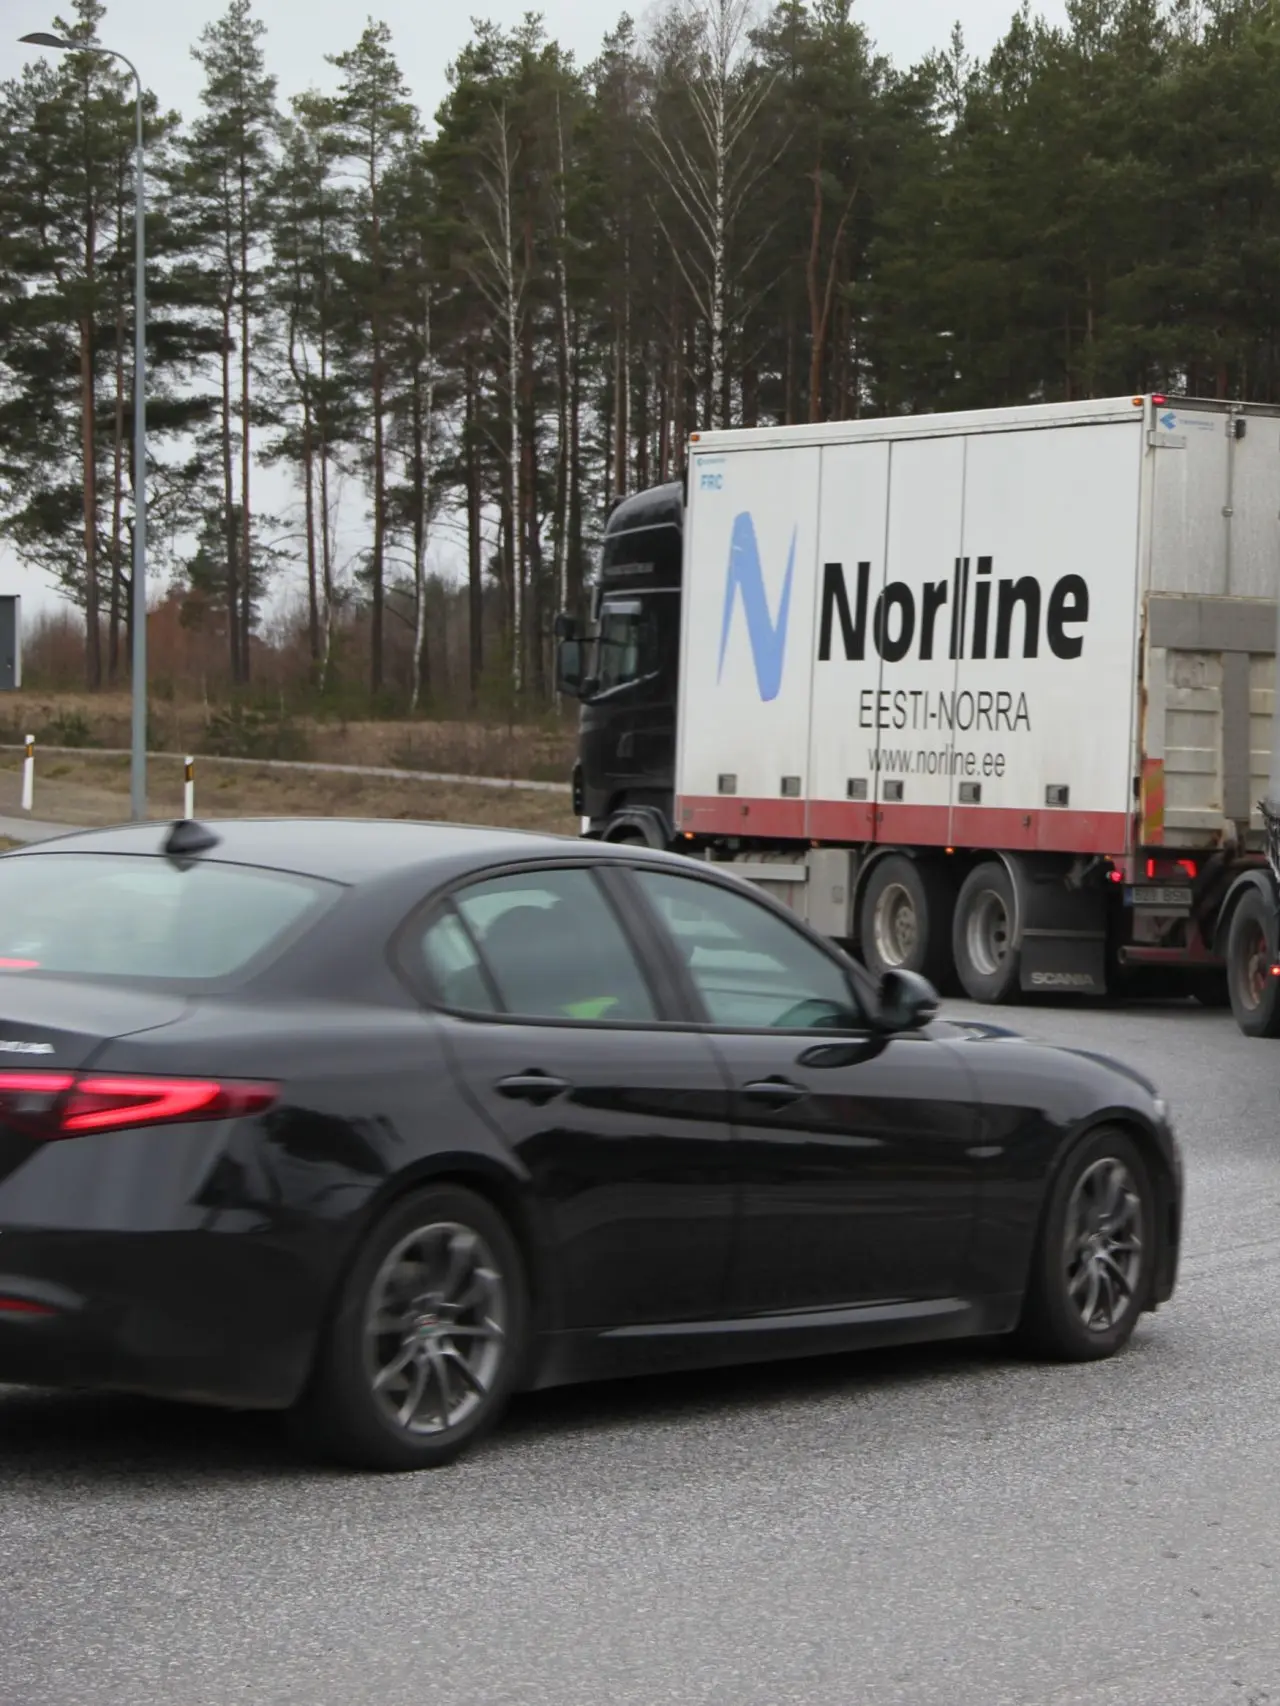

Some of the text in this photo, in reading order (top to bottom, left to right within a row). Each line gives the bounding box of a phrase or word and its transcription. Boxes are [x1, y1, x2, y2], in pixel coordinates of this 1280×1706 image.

[818, 556, 1089, 662] Norline
[859, 690, 1031, 731] EESTI-NORRA
[868, 743, 1006, 777] www.norline.ee
[1031, 972, 1095, 986] SCANIA
